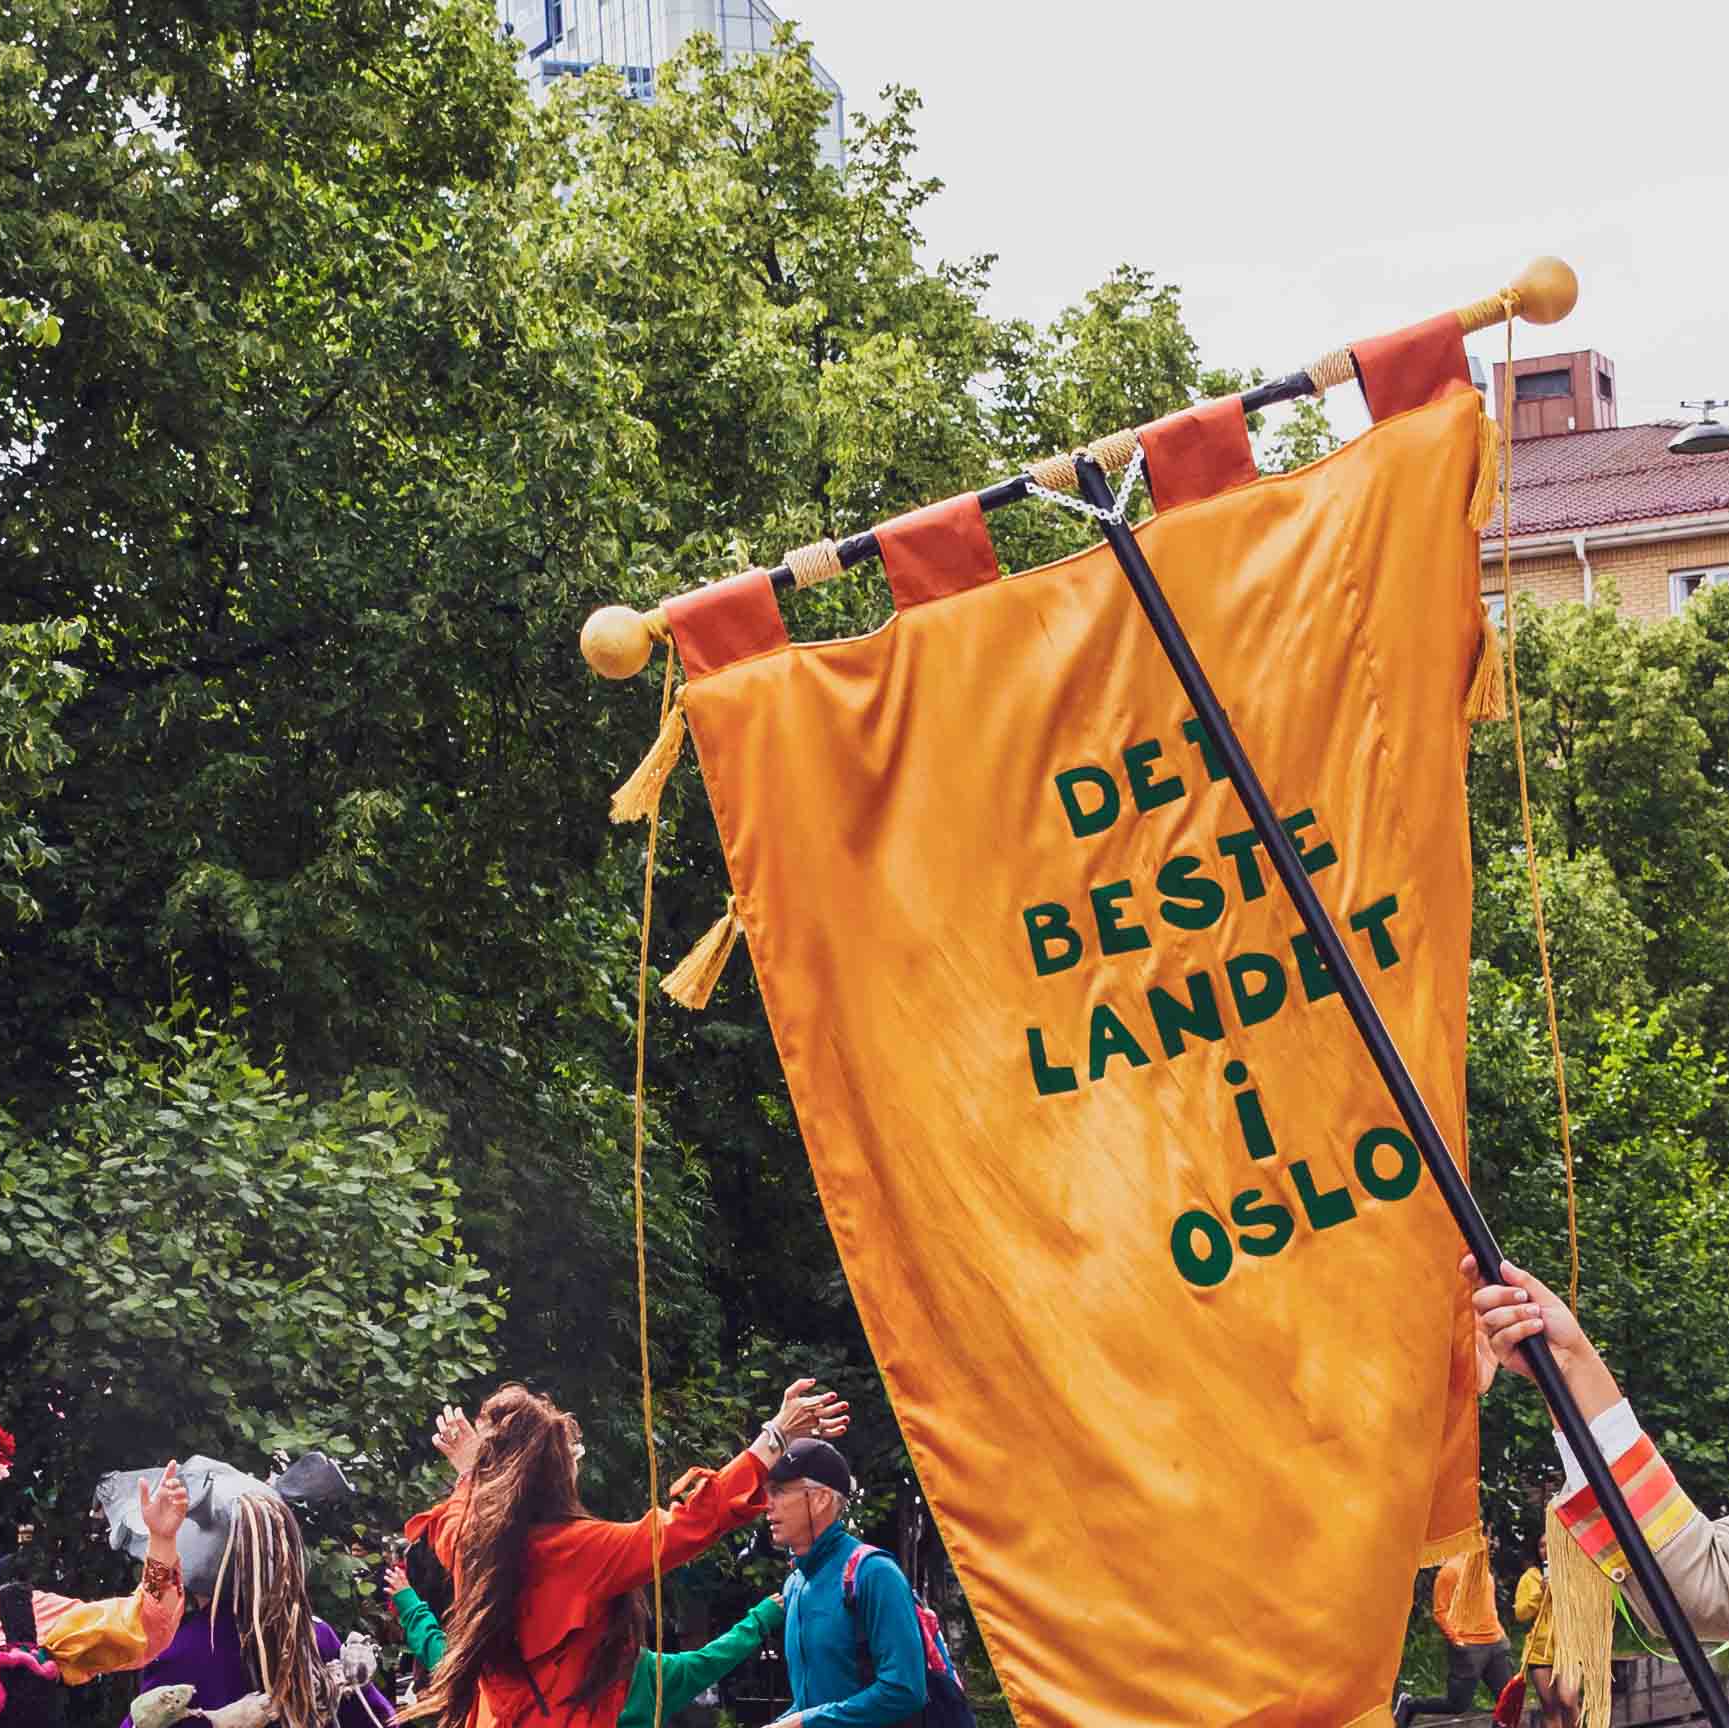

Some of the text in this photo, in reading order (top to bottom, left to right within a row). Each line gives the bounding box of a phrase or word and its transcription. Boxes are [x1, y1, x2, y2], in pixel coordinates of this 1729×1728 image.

[1022, 808, 1338, 976] BESTE
[1026, 894, 1401, 1096] LANDET
[1171, 1127, 1421, 1286] OSLO
